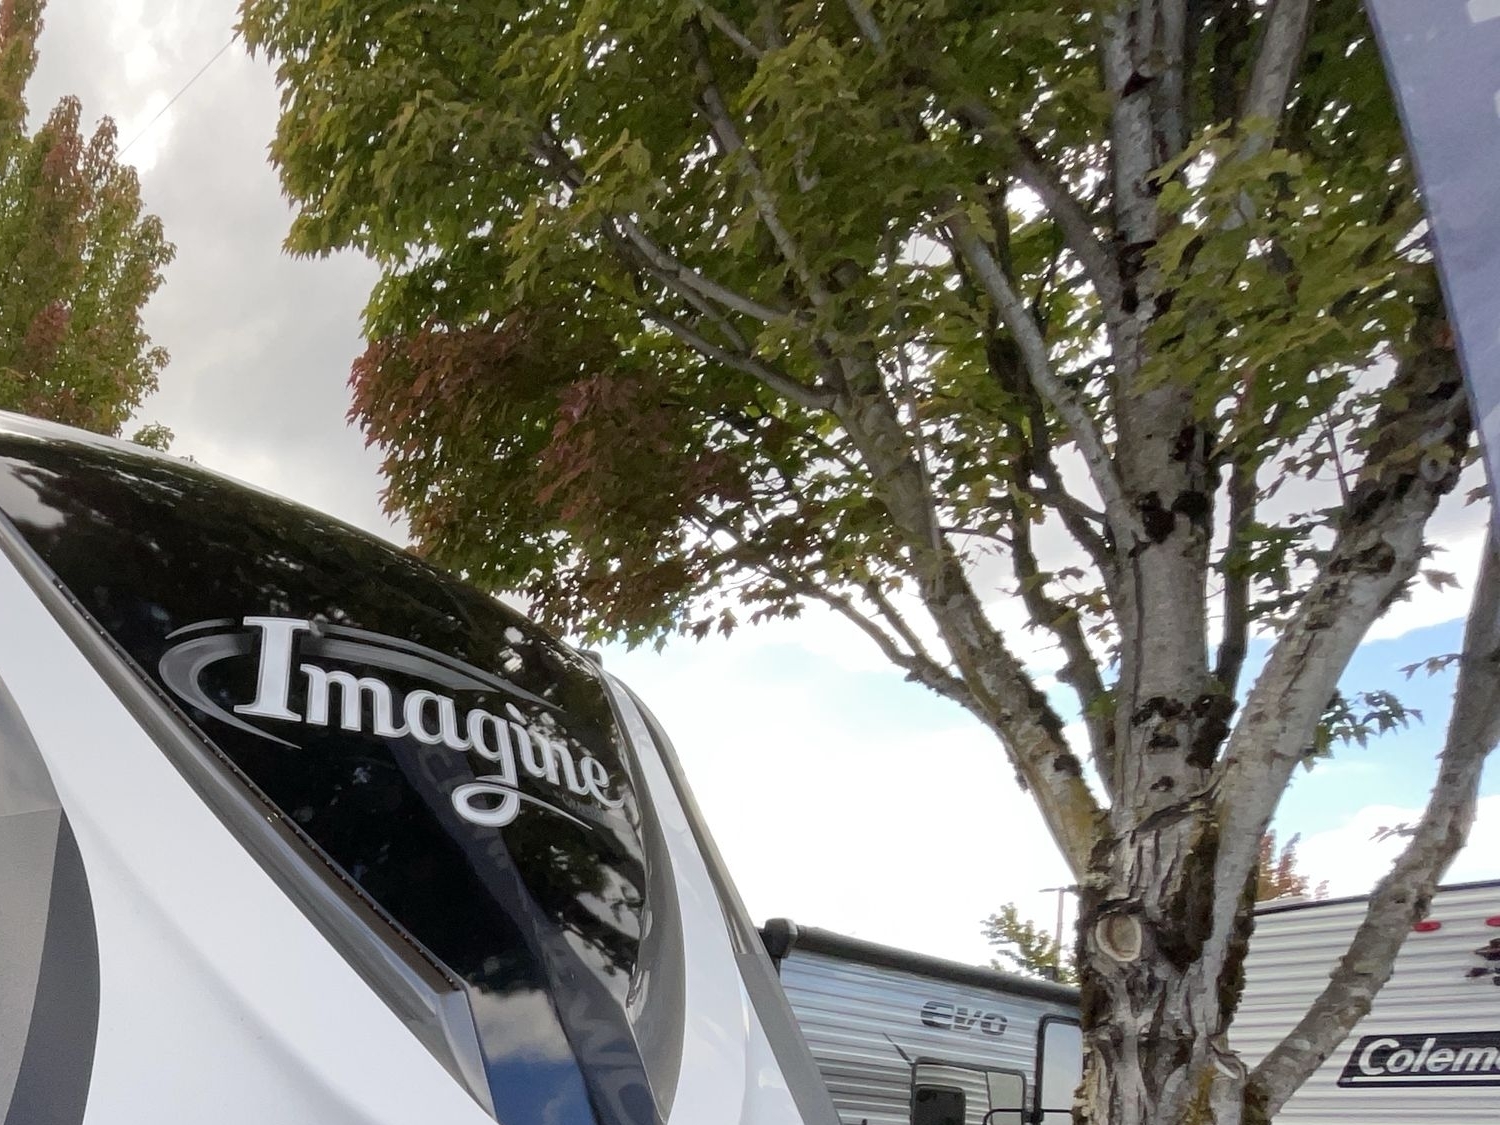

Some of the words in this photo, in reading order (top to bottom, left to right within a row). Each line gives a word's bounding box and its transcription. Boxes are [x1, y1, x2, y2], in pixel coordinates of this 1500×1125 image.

[233, 615, 625, 828] Imagine
[920, 1000, 1008, 1036] EVO
[1358, 1037, 1500, 1076] Colem
